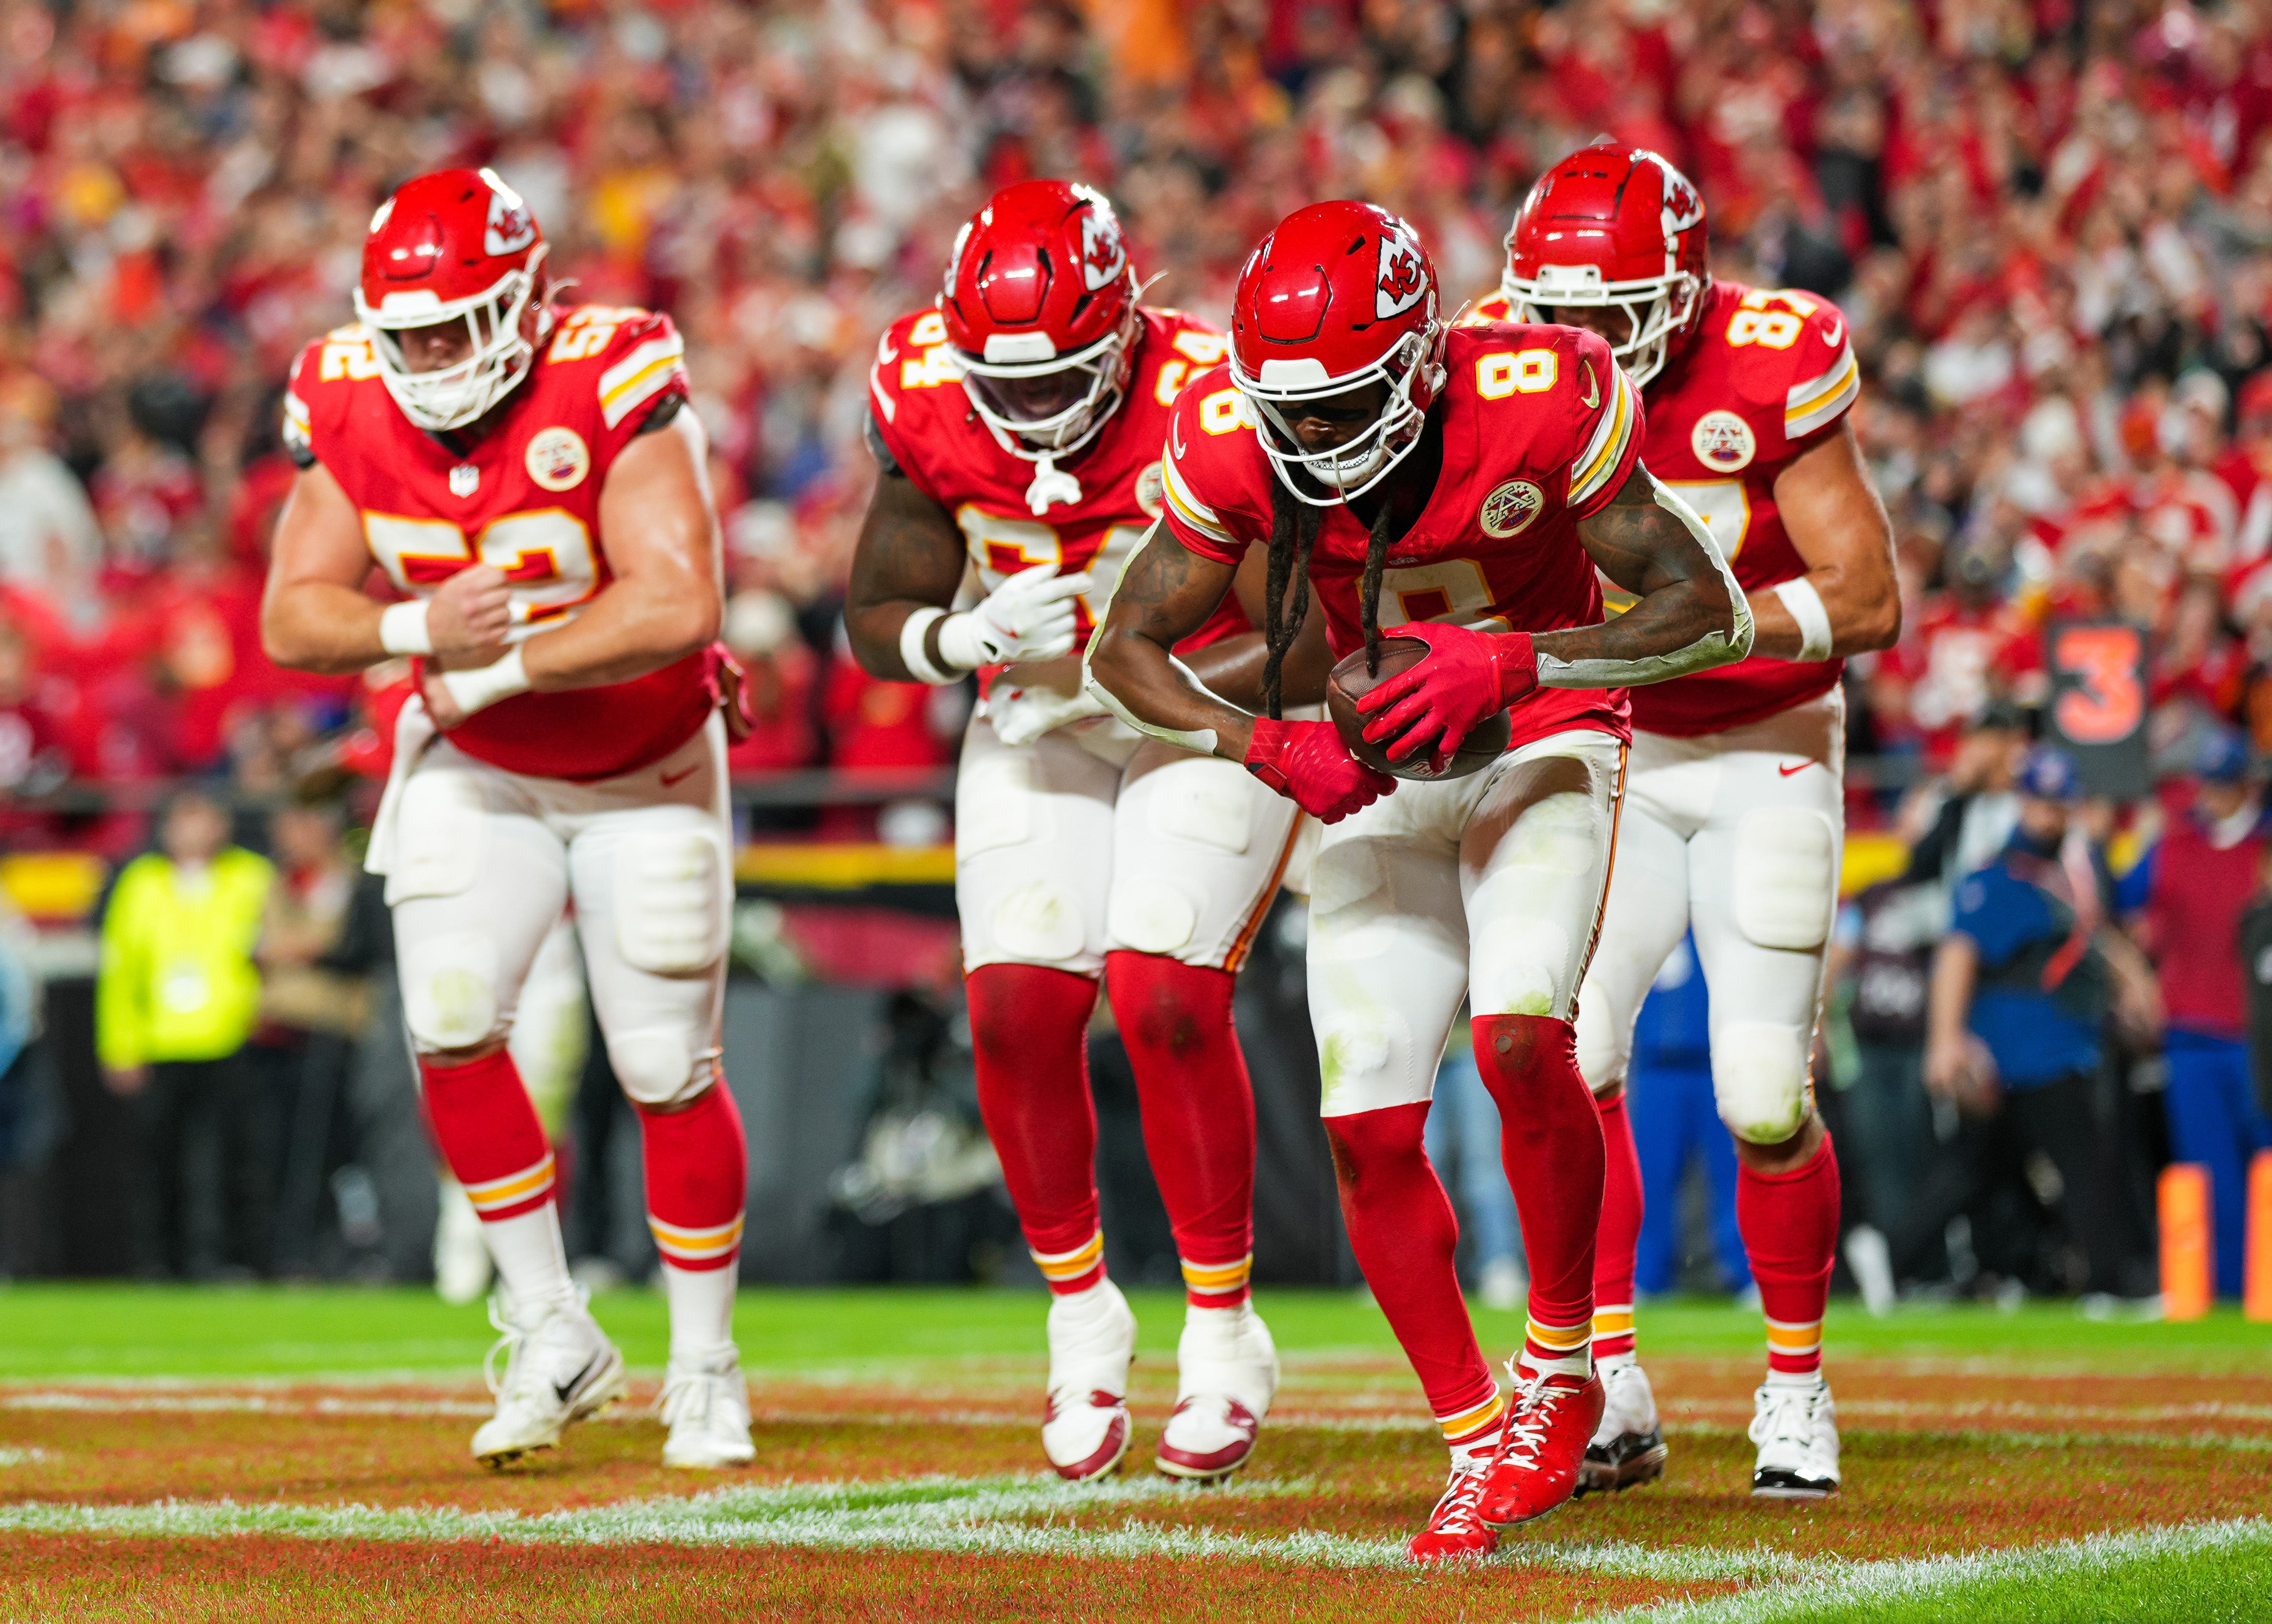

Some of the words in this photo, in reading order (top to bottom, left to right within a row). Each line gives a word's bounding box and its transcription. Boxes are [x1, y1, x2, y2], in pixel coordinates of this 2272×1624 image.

[1378, 248, 1422, 306] KC
[1725, 288, 1819, 350] 87
[1475, 347, 1558, 401] 8
[1489, 485, 1537, 528] A
[2055, 626, 2145, 744] 3
